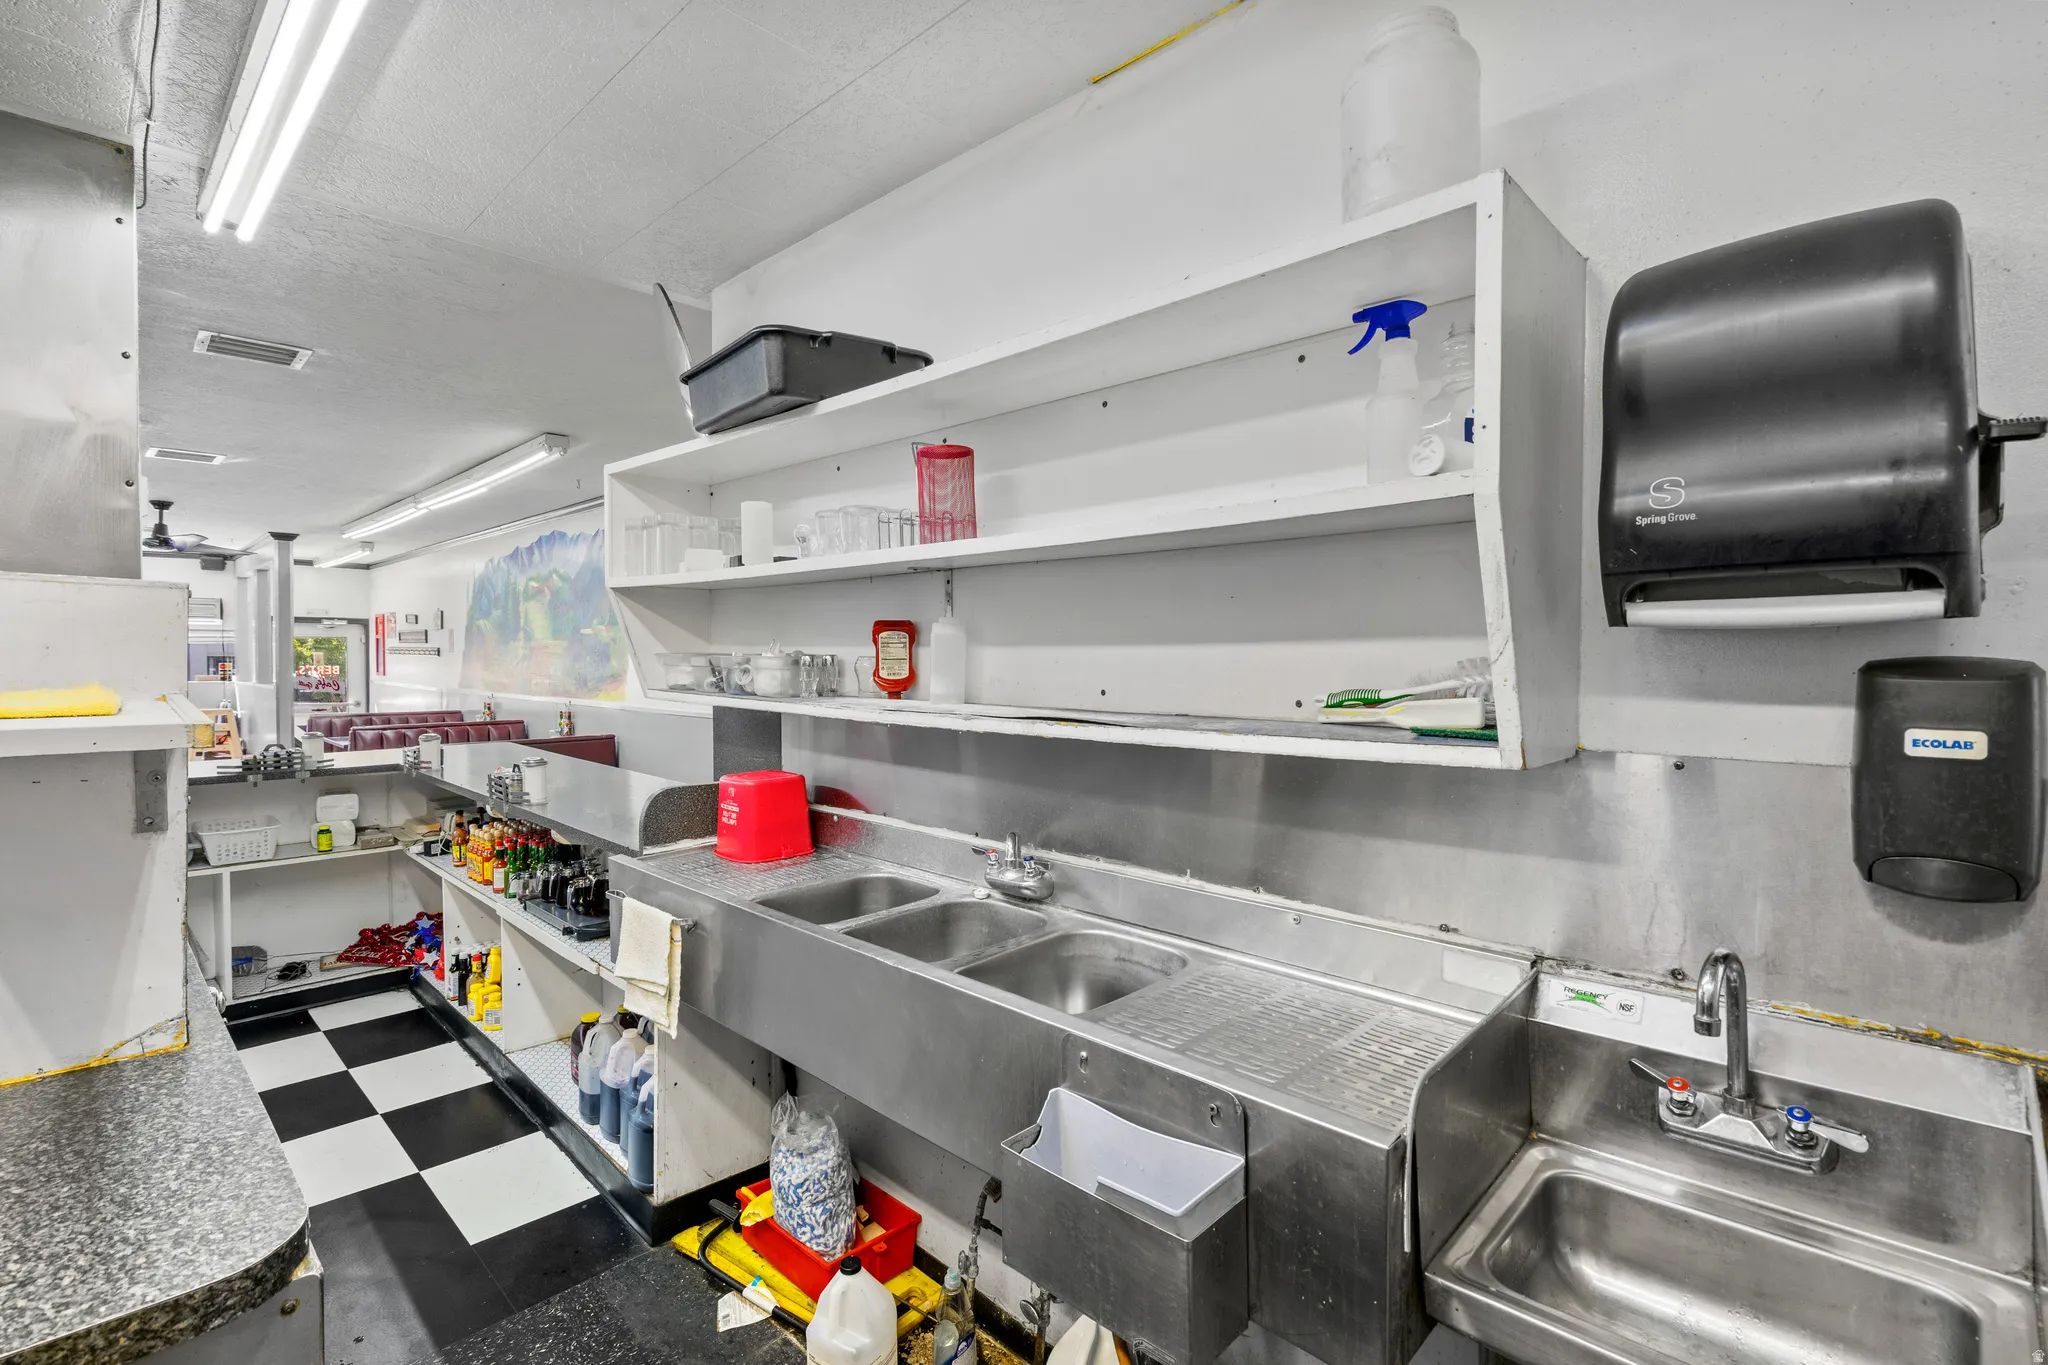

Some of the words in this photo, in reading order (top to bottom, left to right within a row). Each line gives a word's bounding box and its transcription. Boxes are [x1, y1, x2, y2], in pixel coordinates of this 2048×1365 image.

[1635, 514, 1667, 527] Spring
[1911, 738, 1975, 750] ECOLAB
[1563, 986, 1609, 1001] REGENCY
[1618, 1002, 1635, 1013] NSF
